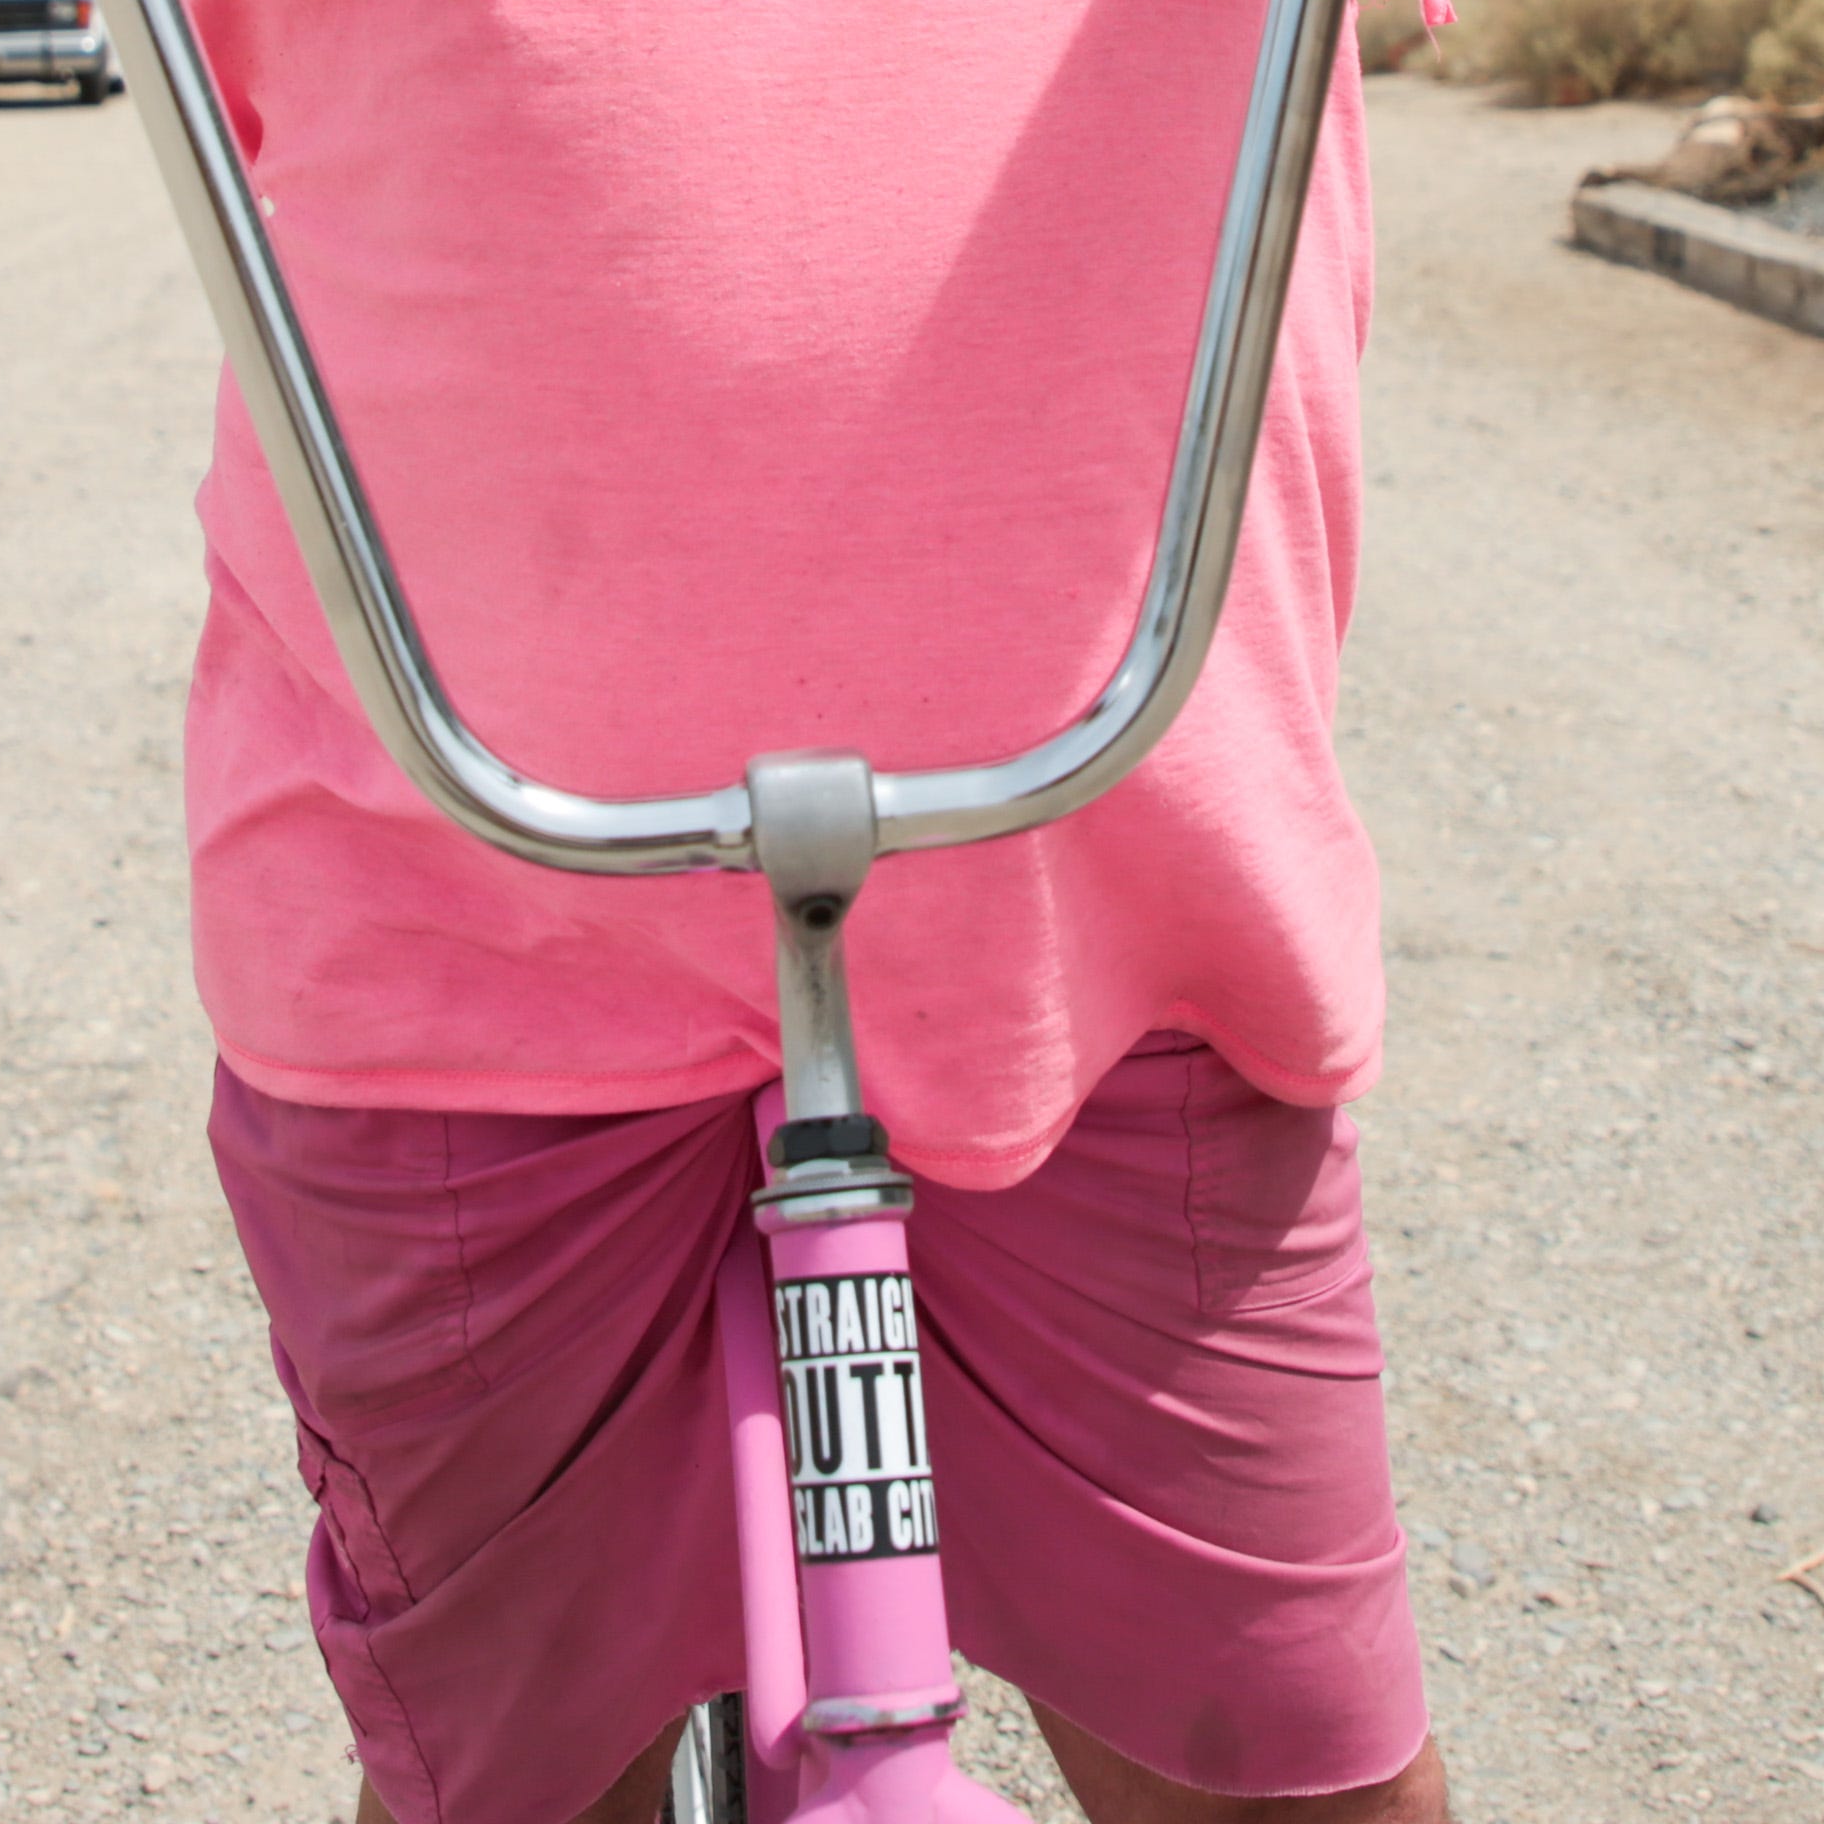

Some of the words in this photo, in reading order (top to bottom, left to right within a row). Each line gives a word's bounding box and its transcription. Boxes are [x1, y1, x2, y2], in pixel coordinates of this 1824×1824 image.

[784, 1360, 930, 1477] OUTT
[794, 1484, 874, 1555] SLAB
[887, 1479, 939, 1551] CIT
